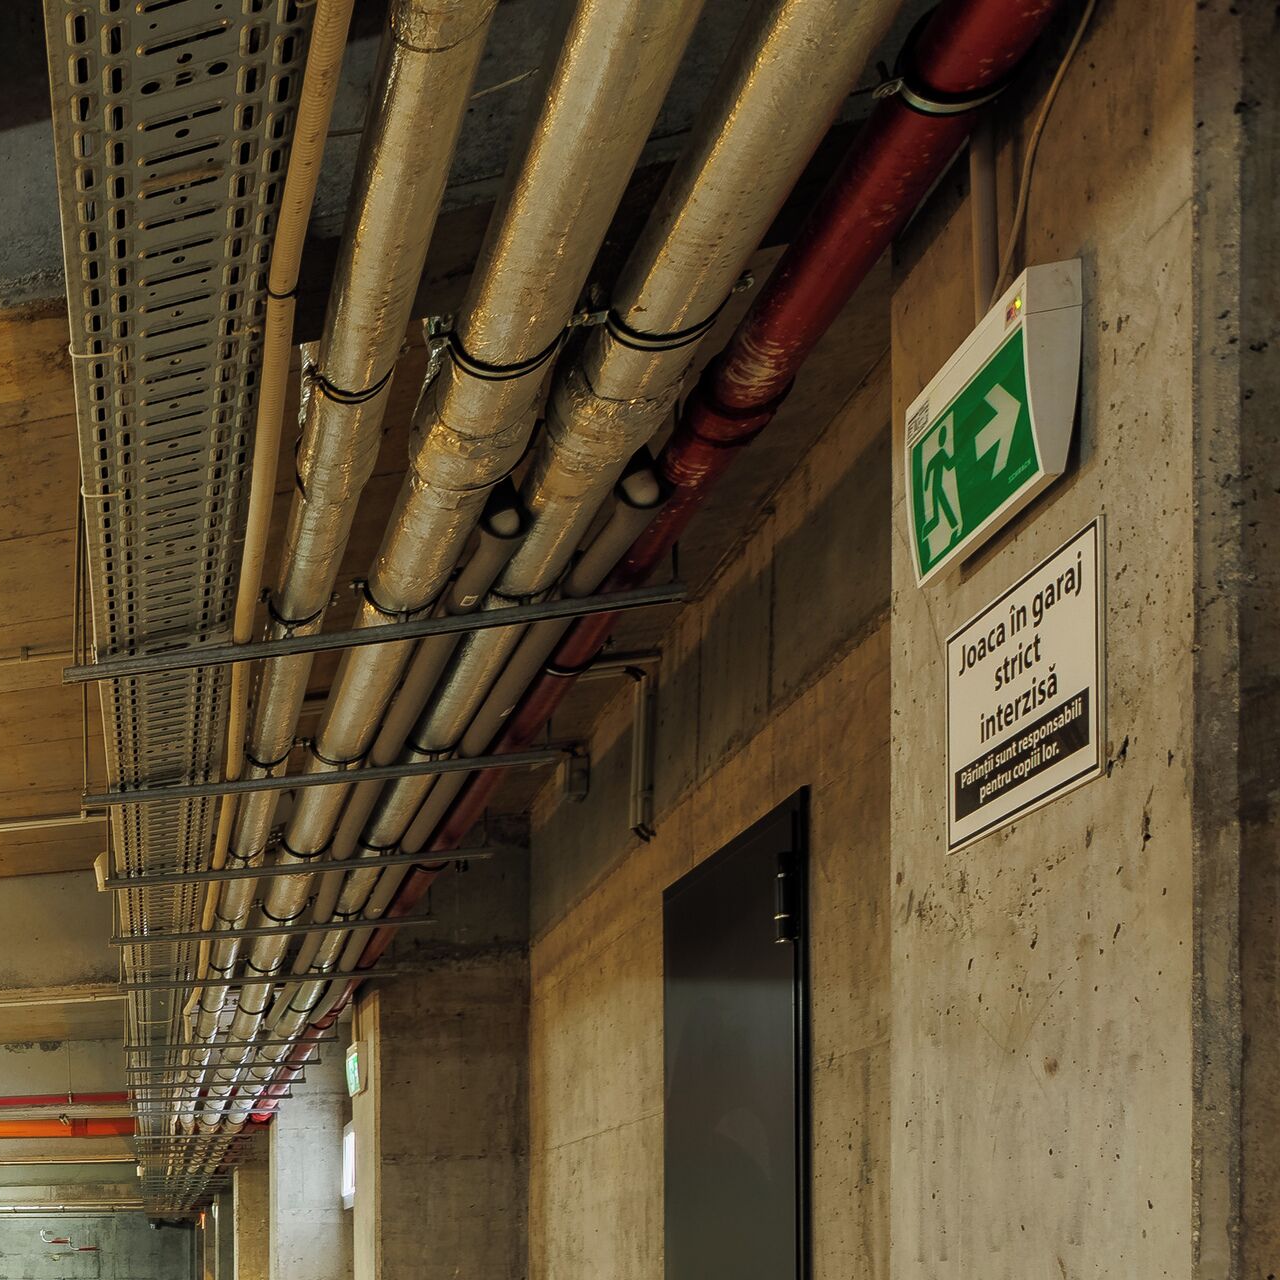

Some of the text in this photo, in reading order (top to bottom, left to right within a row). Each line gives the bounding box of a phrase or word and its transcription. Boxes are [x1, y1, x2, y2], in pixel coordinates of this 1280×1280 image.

[958, 551, 1082, 677] Joaca în garaj
[980, 662, 1058, 744] interzisă
[994, 633, 1041, 692] strict
[960, 697, 1082, 789] Părinții sunt responsabili
[979, 742, 1060, 803] pentru copiii lor.
